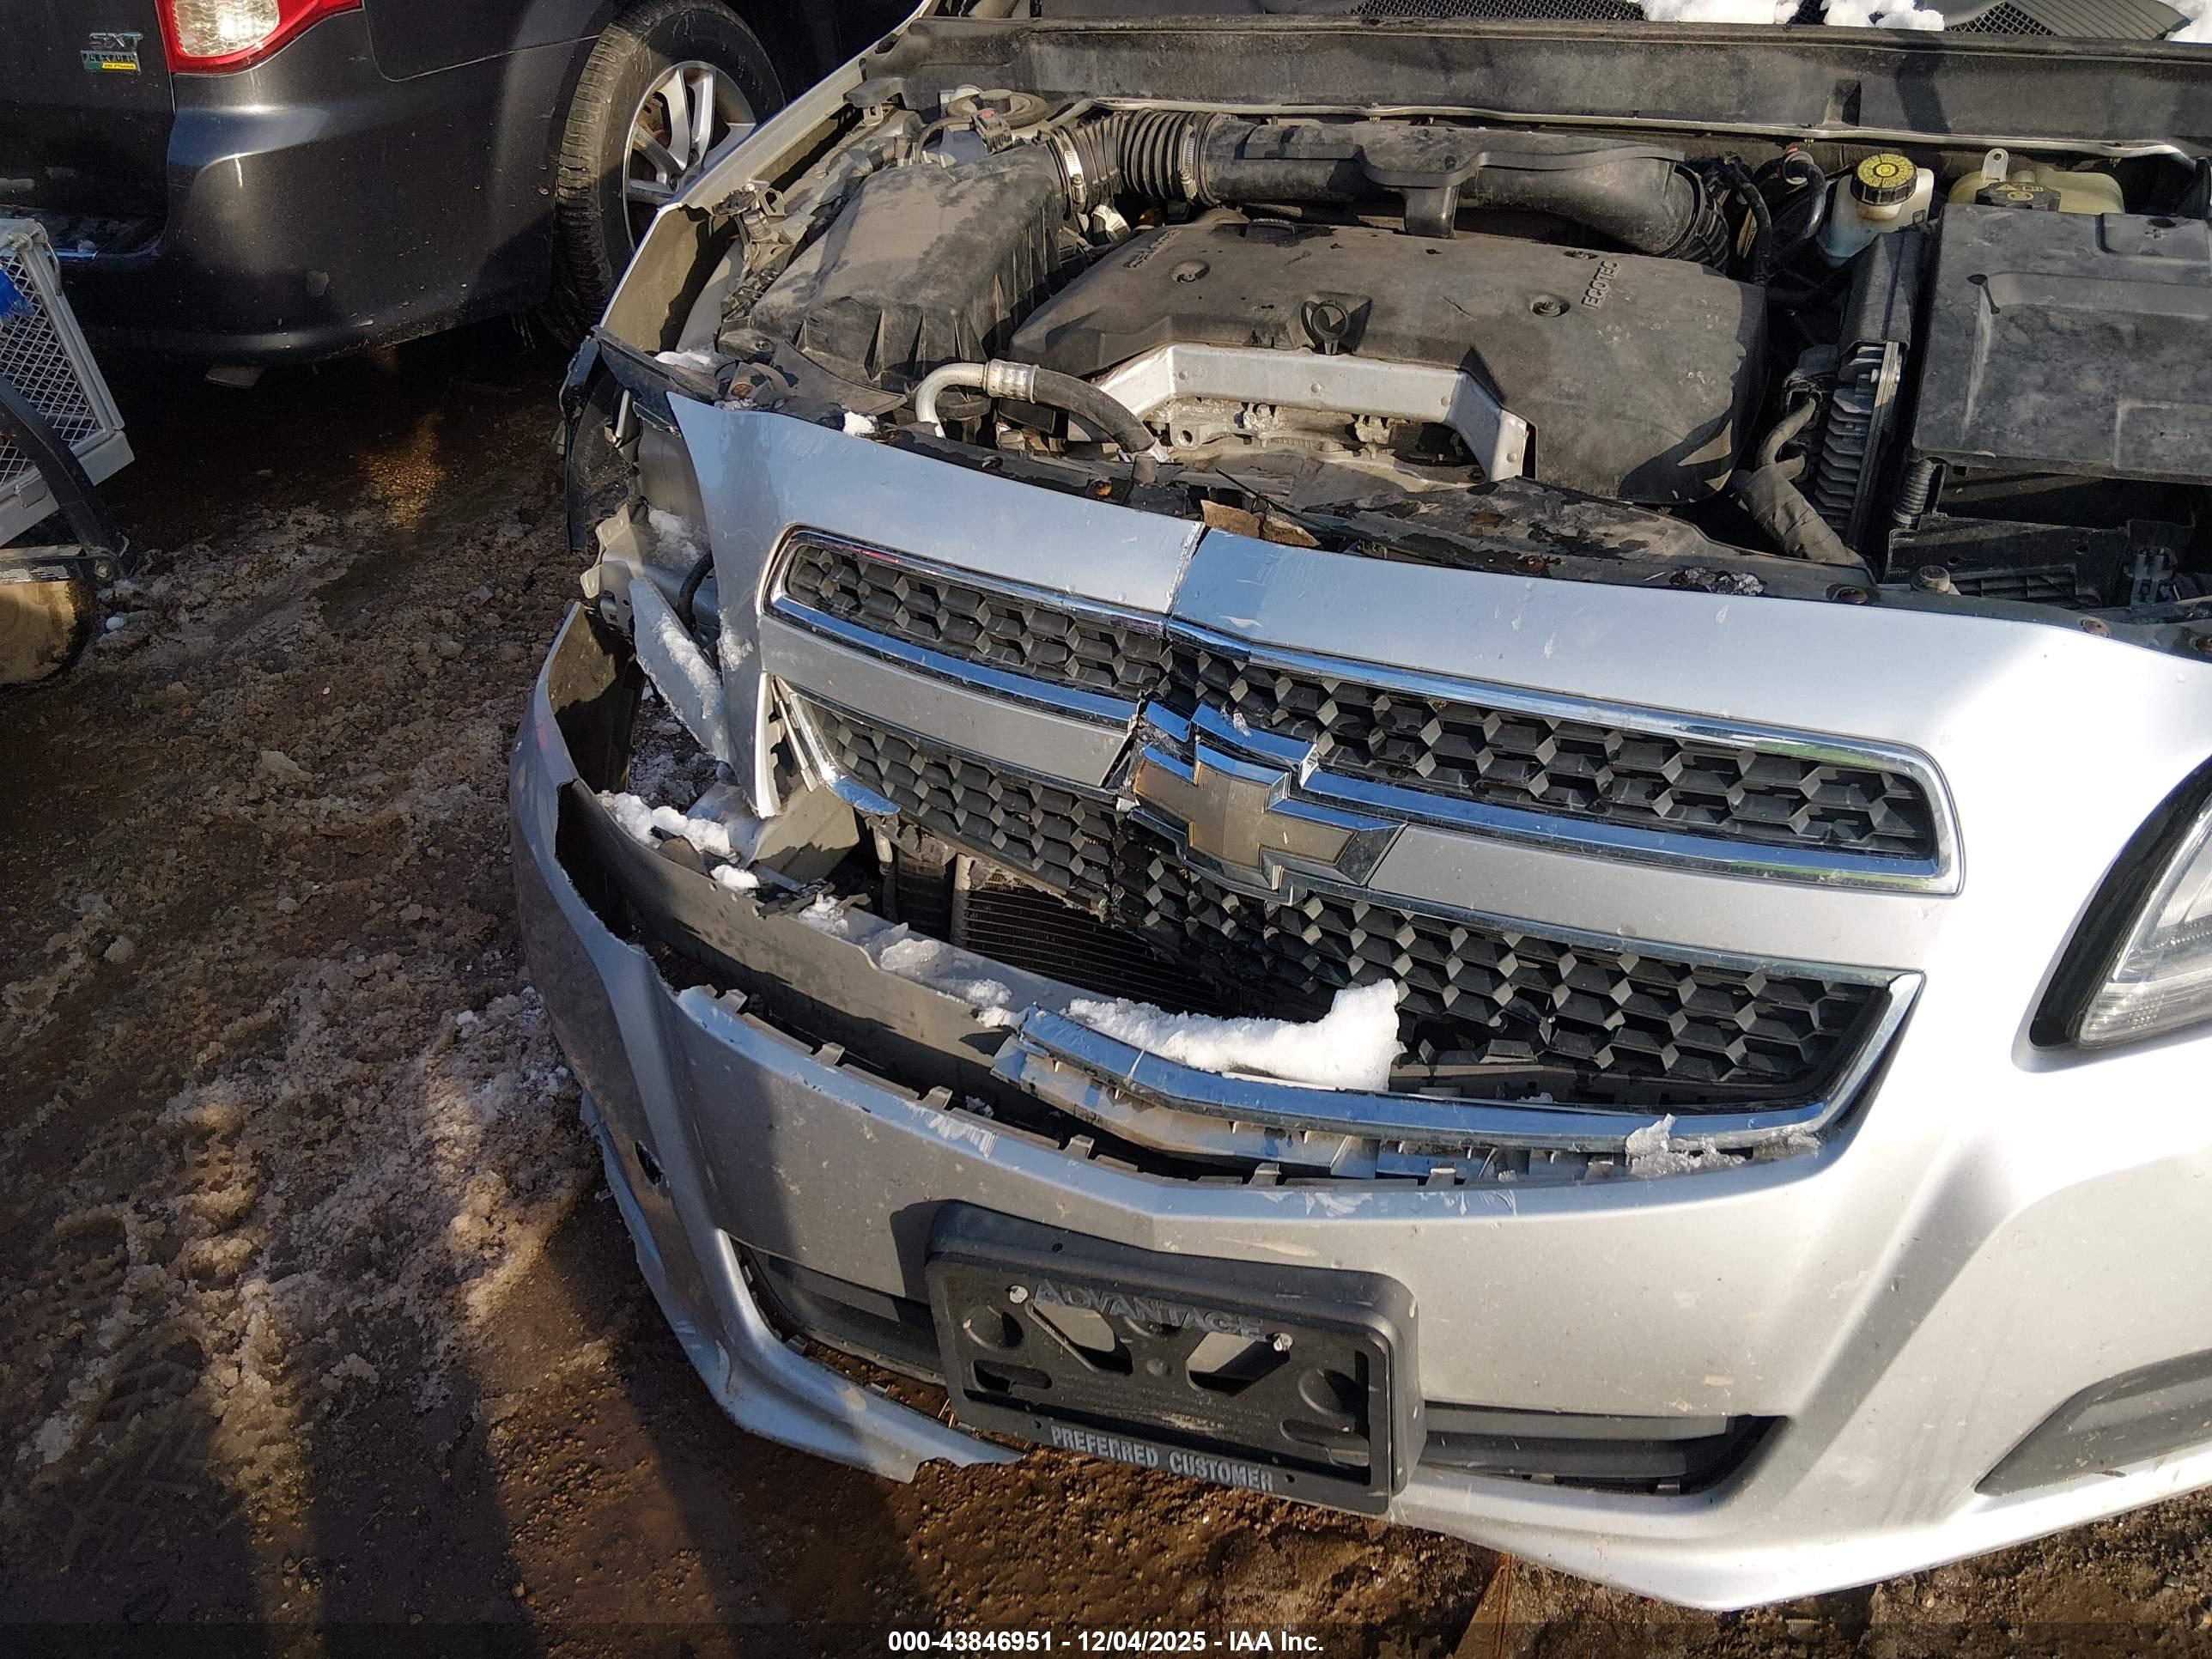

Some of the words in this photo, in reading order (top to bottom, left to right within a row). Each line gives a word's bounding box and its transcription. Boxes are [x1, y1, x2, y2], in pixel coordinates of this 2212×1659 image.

[82, 52, 135, 63] FLEXFUEL
[89, 33, 144, 49] SXT
[1580, 260, 1621, 309] ECOTEC
[1033, 1278, 1265, 1342] ADVANTAGE
[1051, 1425, 1158, 1468] PREFERRED
[1169, 1451, 1273, 1492] CUSTOMER
